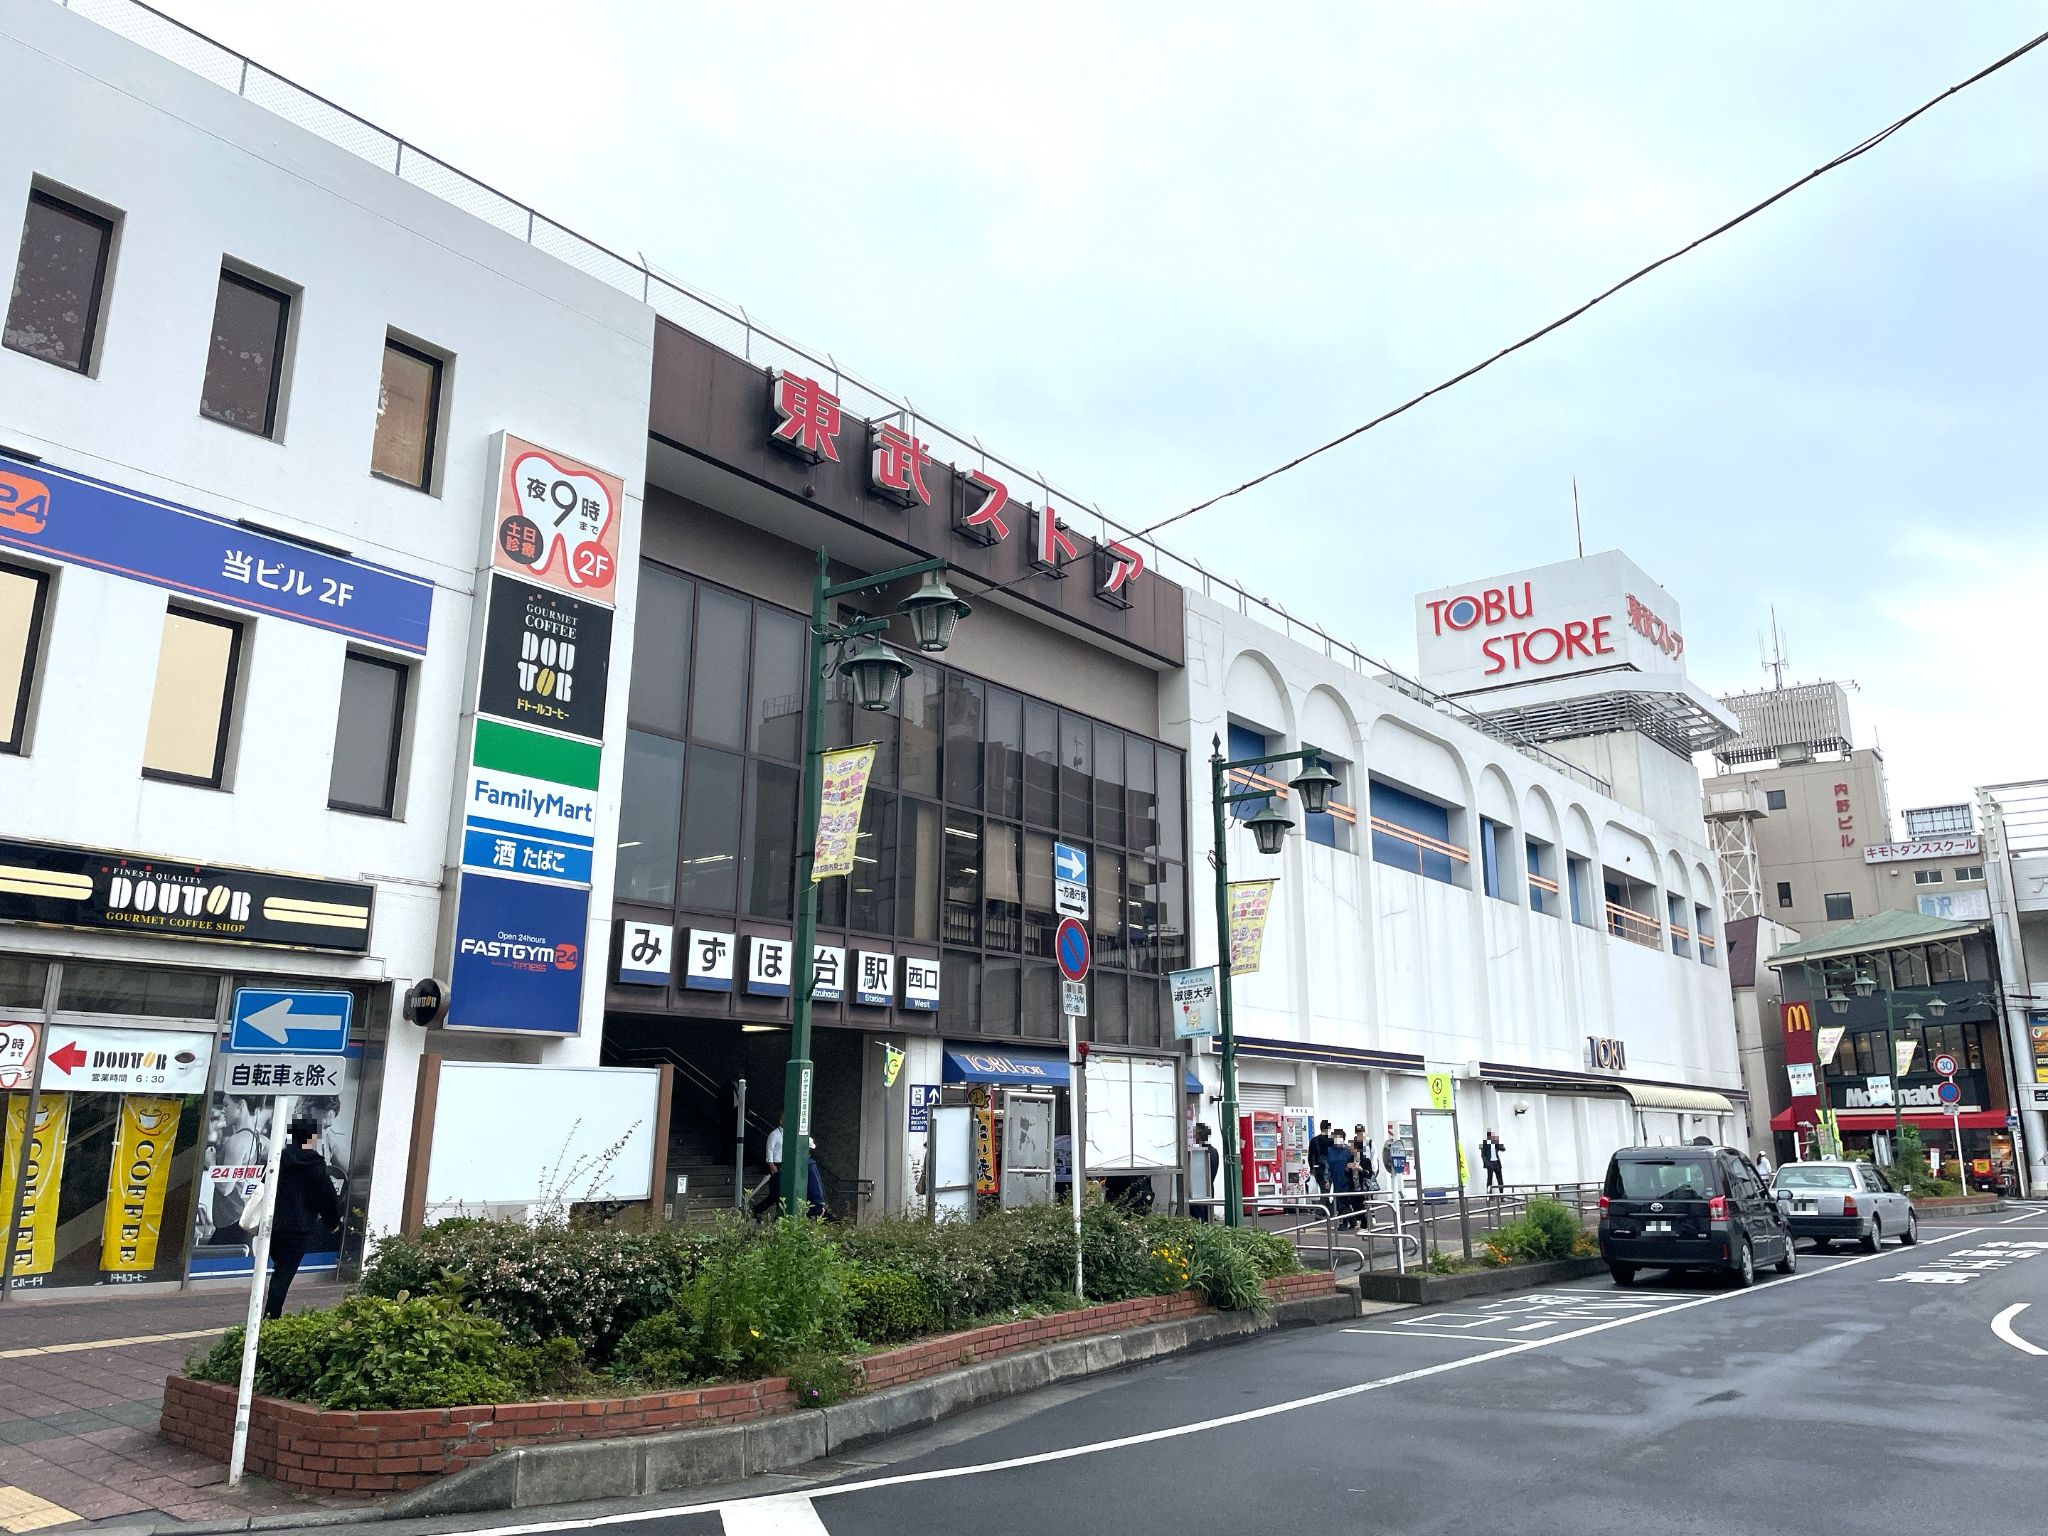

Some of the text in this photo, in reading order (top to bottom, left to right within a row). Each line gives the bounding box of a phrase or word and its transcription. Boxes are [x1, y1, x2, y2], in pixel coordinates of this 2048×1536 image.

[773, 369, 1144, 592] 東武ストア
[507, 522, 536, 542] 土日
[579, 521, 599, 535] まで
[506, 536, 535, 559] 診療
[579, 550, 608, 578] 2F
[222, 549, 355, 608] 当ビル 2F
[526, 603, 579, 626] GOURMET
[1426, 581, 1535, 637] TOBU
[525, 614, 577, 639] COFFEE
[1482, 615, 1615, 676] STORE
[516, 698, 570, 720] ドトールコーヒー
[474, 779, 593, 823] FamilyMart
[1834, 783, 1855, 848] 内野ビル
[493, 838, 565, 873] 酒 たばこ
[1866, 839, 1976, 859] キモトダンススクール
[113, 867, 203, 885] FINEST QUALITY
[109, 876, 251, 921] DOUTOR
[1058, 886, 1087, 902] 一方通行路
[106, 911, 246, 933] GOURMET COFFEE SHOP
[497, 931, 546, 944] Open 24hours
[631, 928, 888, 991] みずほ台駅
[908, 966, 938, 991] 西口
[864, 993, 886, 1004] Station
[914, 1000, 930, 1008] West
[1174, 986, 1213, 1002] 淑徳大学
[93, 1050, 168, 1070] DOUTOR
[960, 1054, 1019, 1074] TOBU
[1940, 1061, 1952, 1071] 30
[91, 1073, 165, 1083] 営業時間 6:30
[232, 1063, 338, 1087] 自転車を除く
[911, 1108, 928, 1116] エレベー
[211, 1168, 229, 1179] 24
[120, 1140, 155, 1265] COFFEE
